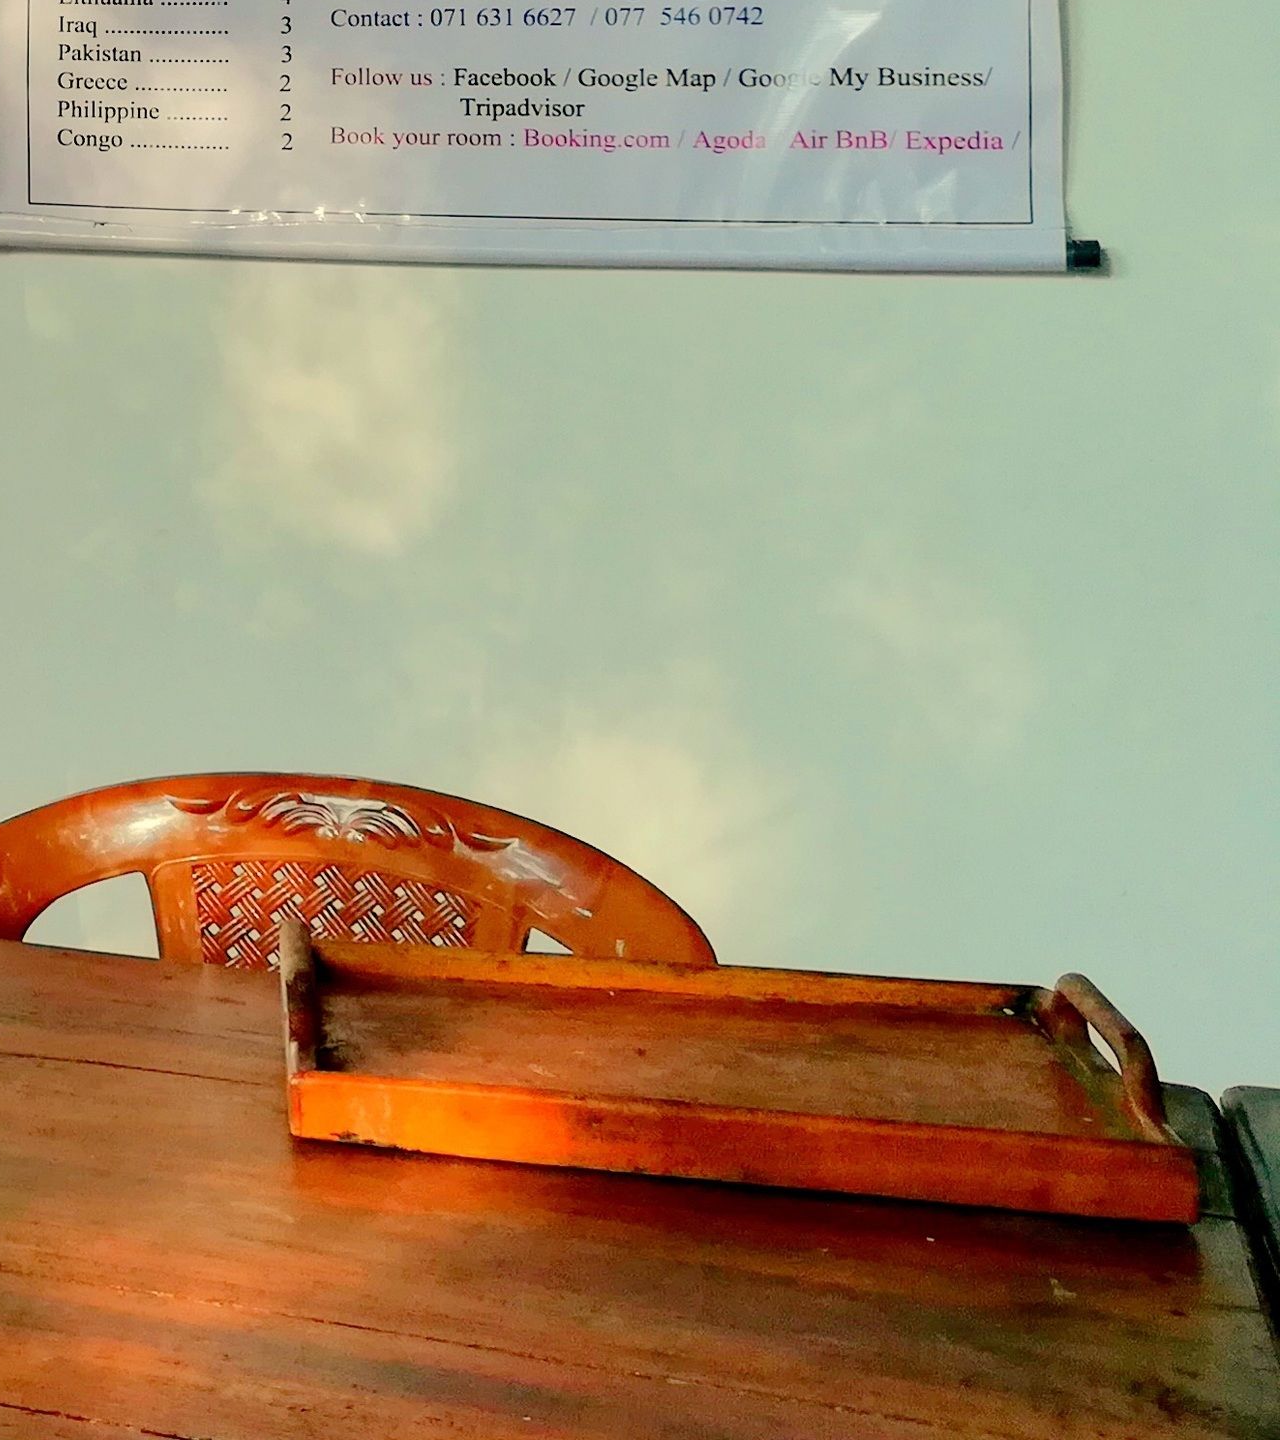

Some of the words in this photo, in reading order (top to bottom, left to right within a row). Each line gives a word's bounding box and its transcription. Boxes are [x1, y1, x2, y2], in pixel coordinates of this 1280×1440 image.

[331, 9, 410, 27] Contact
[430, 8, 466, 27] 071
[476, 8, 513, 26] 631
[523, 8, 576, 26] 6627
[605, 7, 645, 26] 077
[660, 7, 700, 26] 546
[708, 7, 765, 26] 0742
[58, 44, 142, 62] Pakistan
[331, 67, 403, 86] Follow
[410, 71, 433, 86] us
[454, 68, 556, 87] Facebook
[578, 68, 658, 92] Google
[666, 68, 716, 92] Map
[830, 68, 869, 91] My
[58, 100, 160, 123] Philippine
[460, 98, 586, 121] Tripadvisor
[57, 128, 123, 151] Congo
[331, 127, 384, 148] Book
[393, 130, 441, 150] your
[447, 131, 502, 147] room
[524, 128, 670, 153] Booking.com
[693, 131, 766, 155] Agoda
[790, 131, 828, 149] Air
[905, 130, 1003, 155] Expedia
